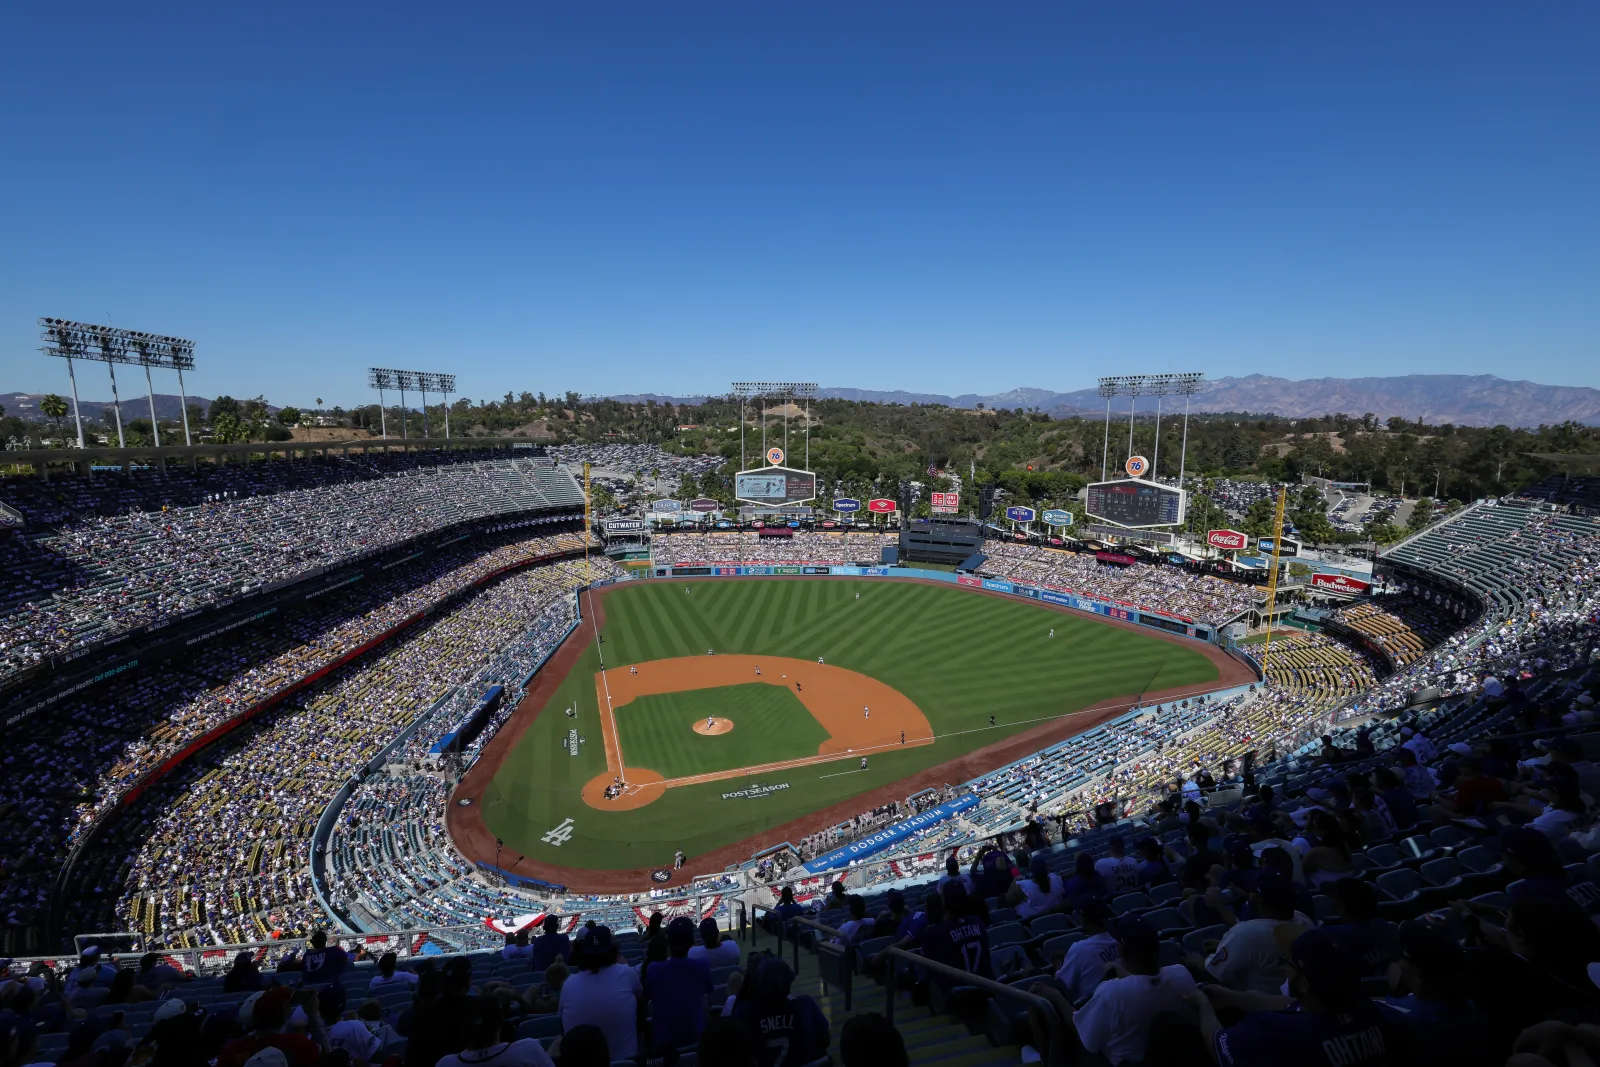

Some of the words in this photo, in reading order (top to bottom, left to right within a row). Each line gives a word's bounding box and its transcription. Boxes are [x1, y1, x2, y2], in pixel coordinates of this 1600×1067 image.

[1130, 462, 1141, 470] 76
[608, 522, 640, 530] CUTWATER
[986, 582, 1008, 590] Spectrum
[1317, 579, 1364, 594] Budweiser
[72, 648, 91, 660] NLDS
[7, 713, 21, 726] Make
[26, 706, 38, 716] Play
[46, 697, 58, 706] Your
[58, 686, 76, 700] Mental
[722, 783, 790, 799] POSTSEASON
[540, 817, 575, 847] LA
[850, 830, 897, 853] DODGER
[899, 809, 944, 832] STADIUM
[950, 924, 982, 943] OHTANI
[960, 940, 982, 973] 17
[760, 1013, 796, 1035] SNELL
[765, 1036, 790, 1067] 7
